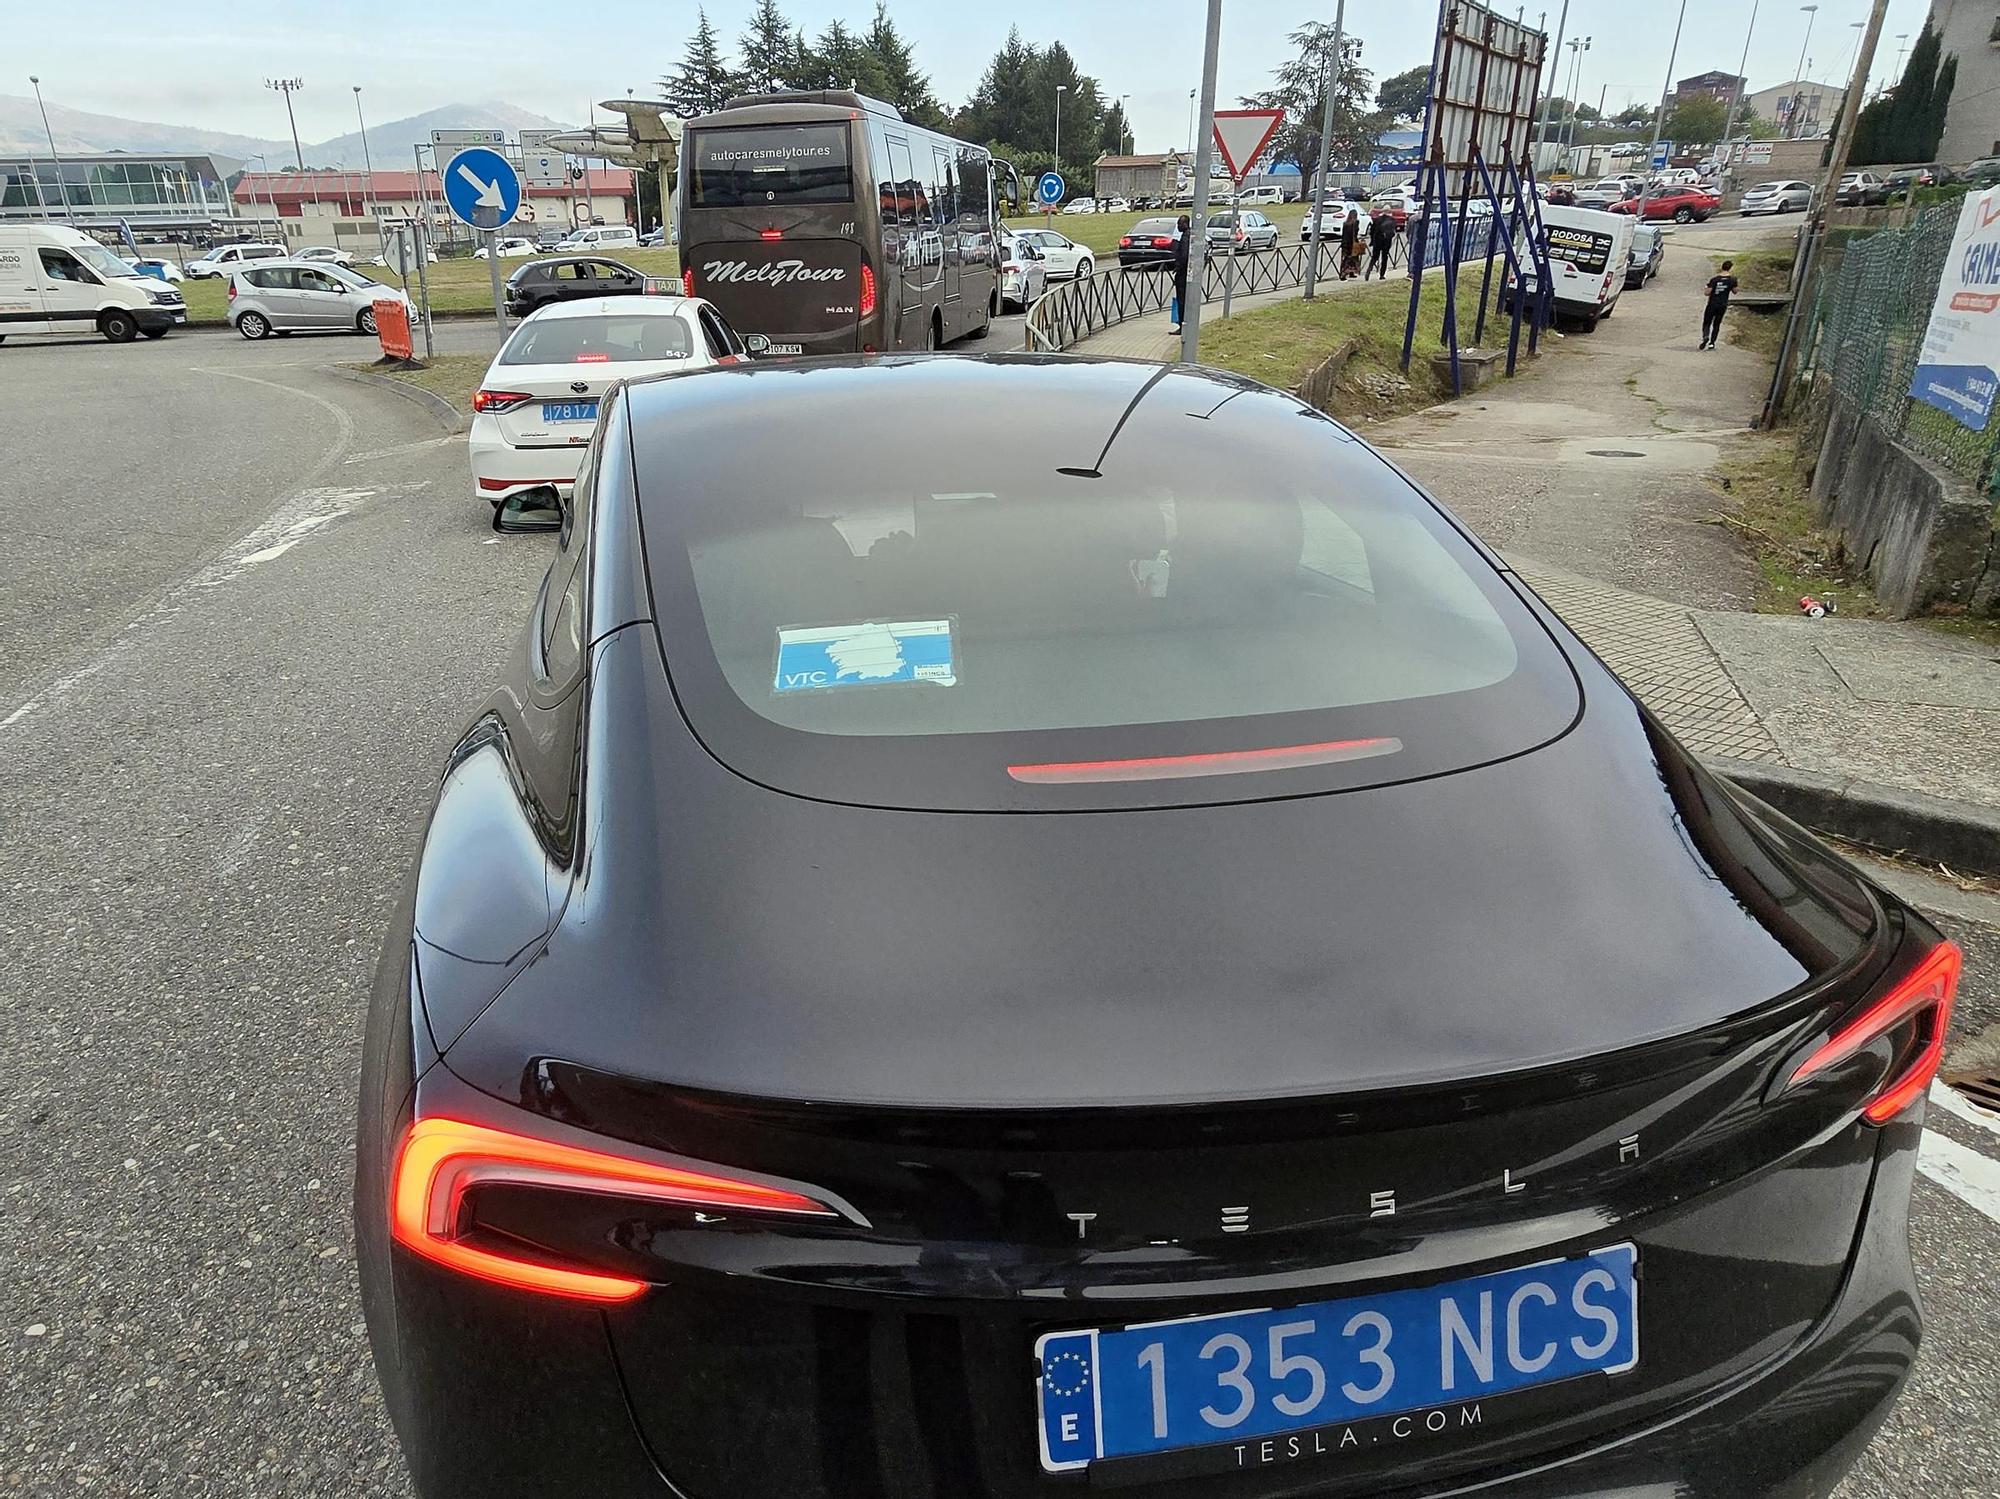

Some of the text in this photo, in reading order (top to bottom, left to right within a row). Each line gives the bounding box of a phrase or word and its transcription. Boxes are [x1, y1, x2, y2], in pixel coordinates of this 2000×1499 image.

[711, 146, 831, 161] autocaresmelytour.es
[840, 222, 855, 234] 198
[1551, 229, 1594, 244] RODOSA
[703, 259, 846, 287] MelyTour
[656, 280, 676, 292] TAXI
[785, 345, 801, 353] KSW
[552, 404, 591, 419] 7817
[786, 672, 827, 686] VTC
[1066, 1133, 1640, 1239] TESLA
[1061, 1268, 1621, 1442] E 1353 NCS
[1234, 1403, 1484, 1466] TESLA.COM
